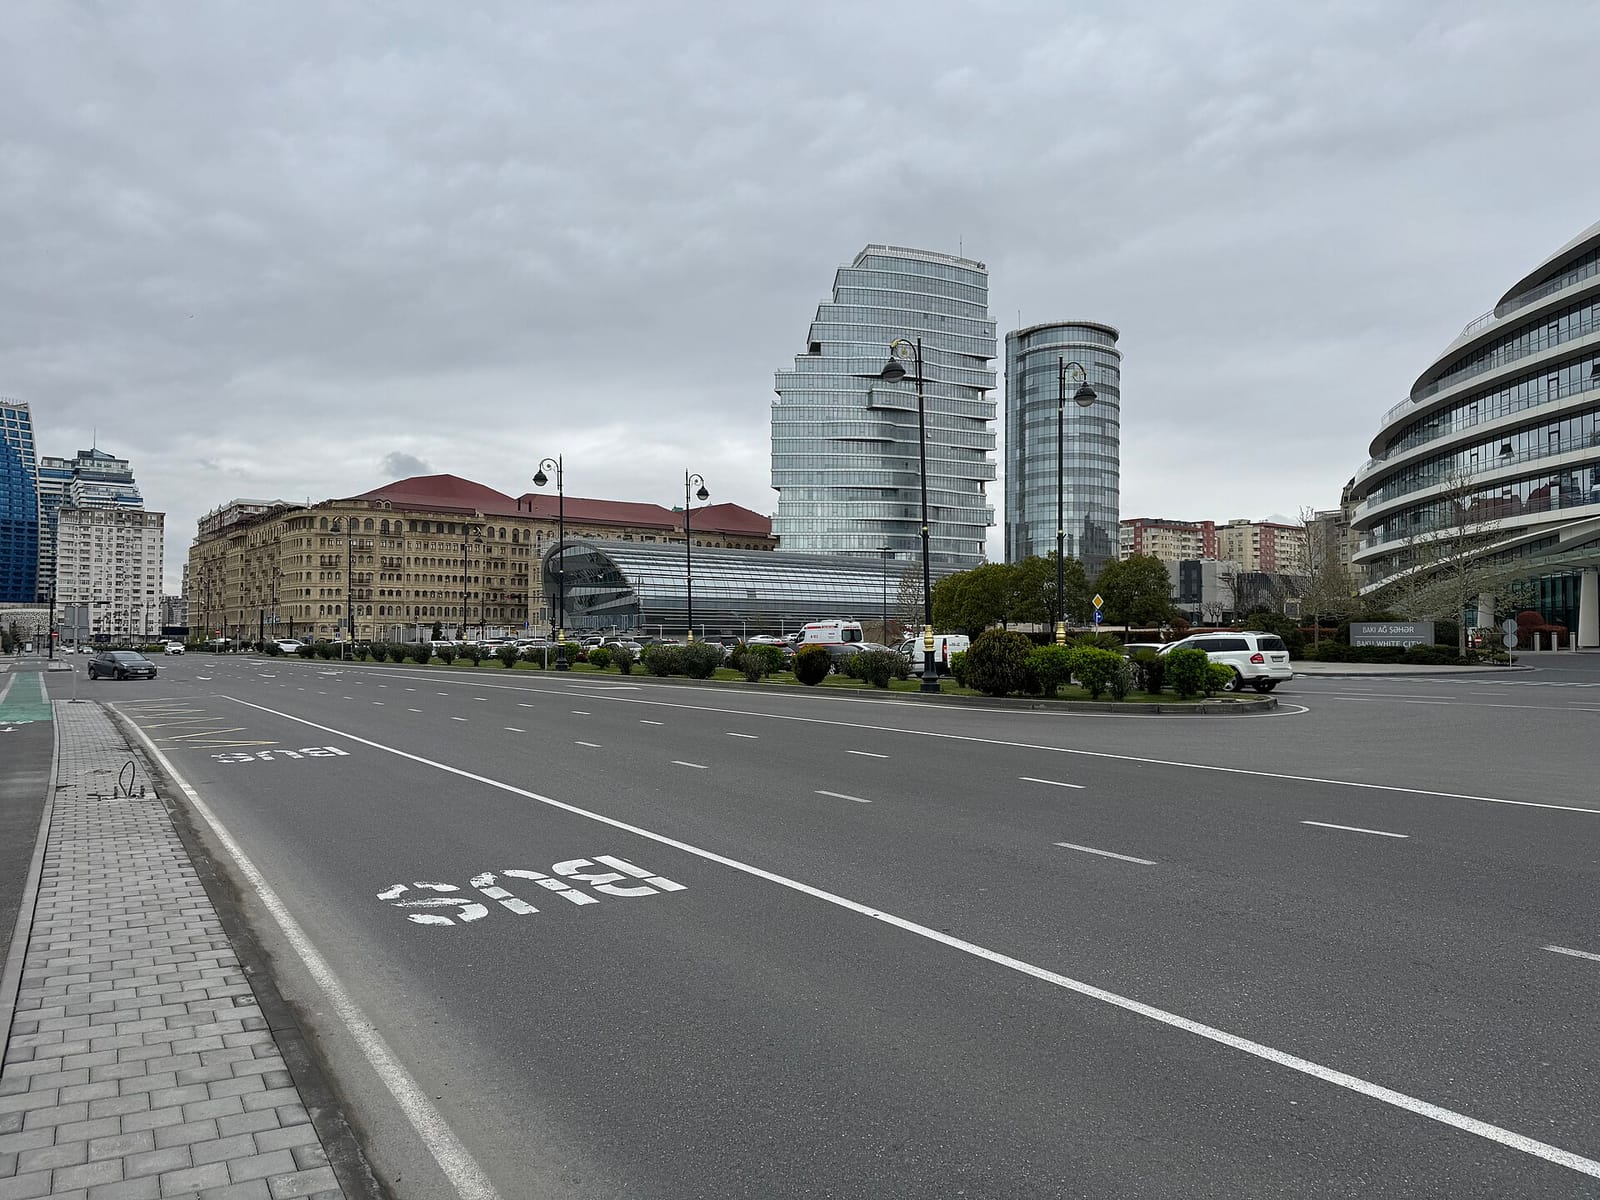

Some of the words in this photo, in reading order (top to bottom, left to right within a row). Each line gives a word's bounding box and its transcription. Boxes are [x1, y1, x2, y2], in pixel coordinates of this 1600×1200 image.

[1362, 626, 1376, 634] BAKI
[1377, 625, 1388, 634] AĞ
[211, 746, 350, 763] BUS
[376, 855, 689, 926] BUS
